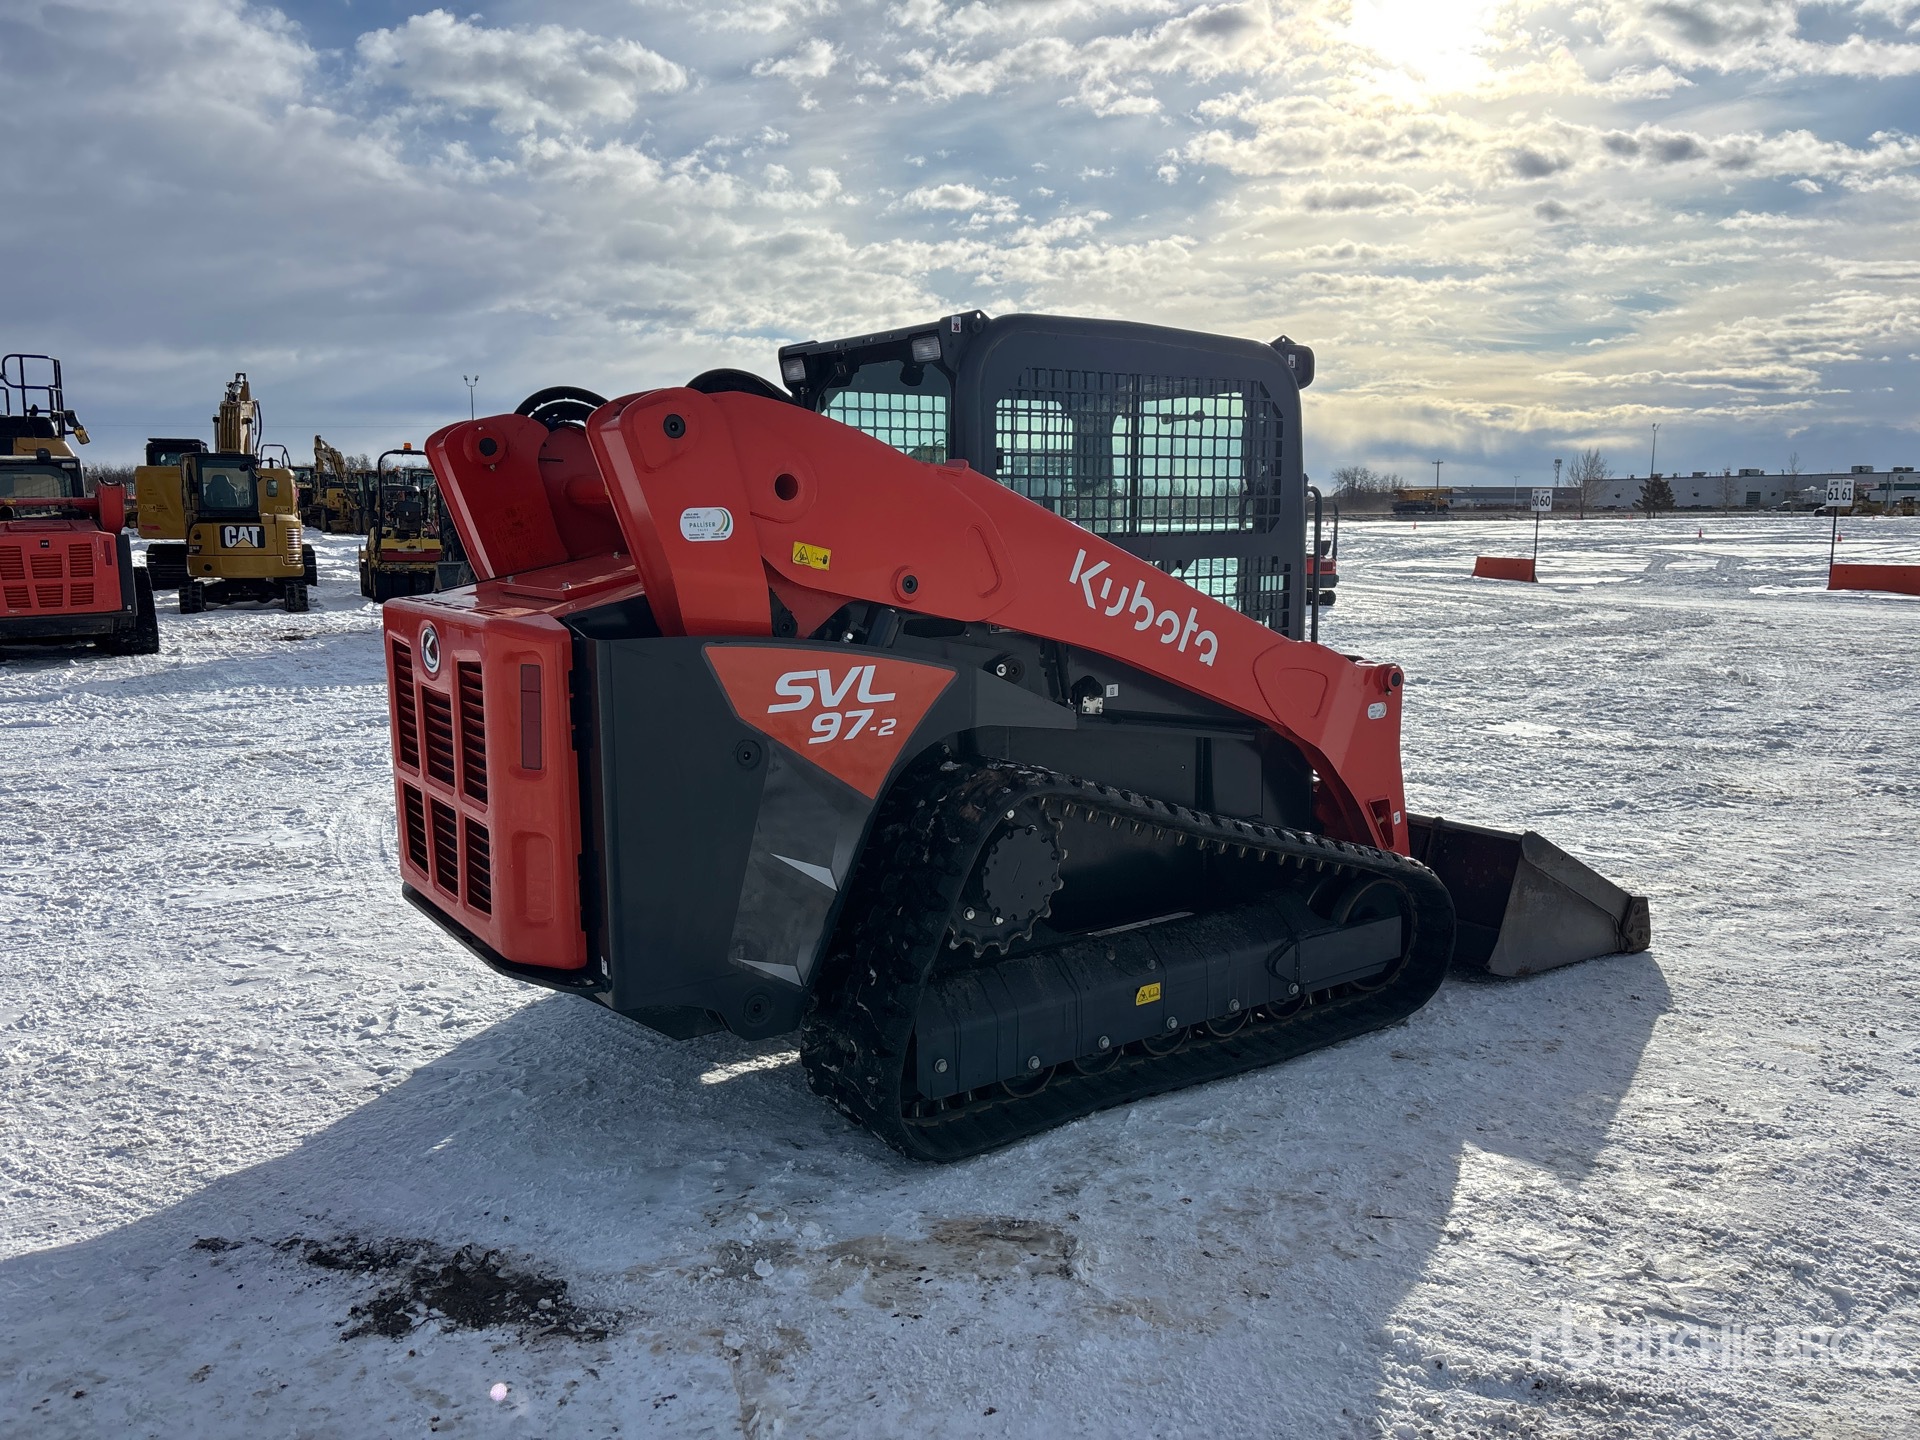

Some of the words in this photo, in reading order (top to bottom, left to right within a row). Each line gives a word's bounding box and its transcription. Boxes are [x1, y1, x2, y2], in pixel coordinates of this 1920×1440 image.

[1540, 495, 1551, 506] 60
[1828, 487, 1839, 500] 61
[1841, 487, 1851, 500] 61
[224, 525, 260, 548] CAT
[1069, 548, 1218, 667] Kubota
[767, 665, 896, 713] SVL
[808, 709, 897, 745] 97-2
